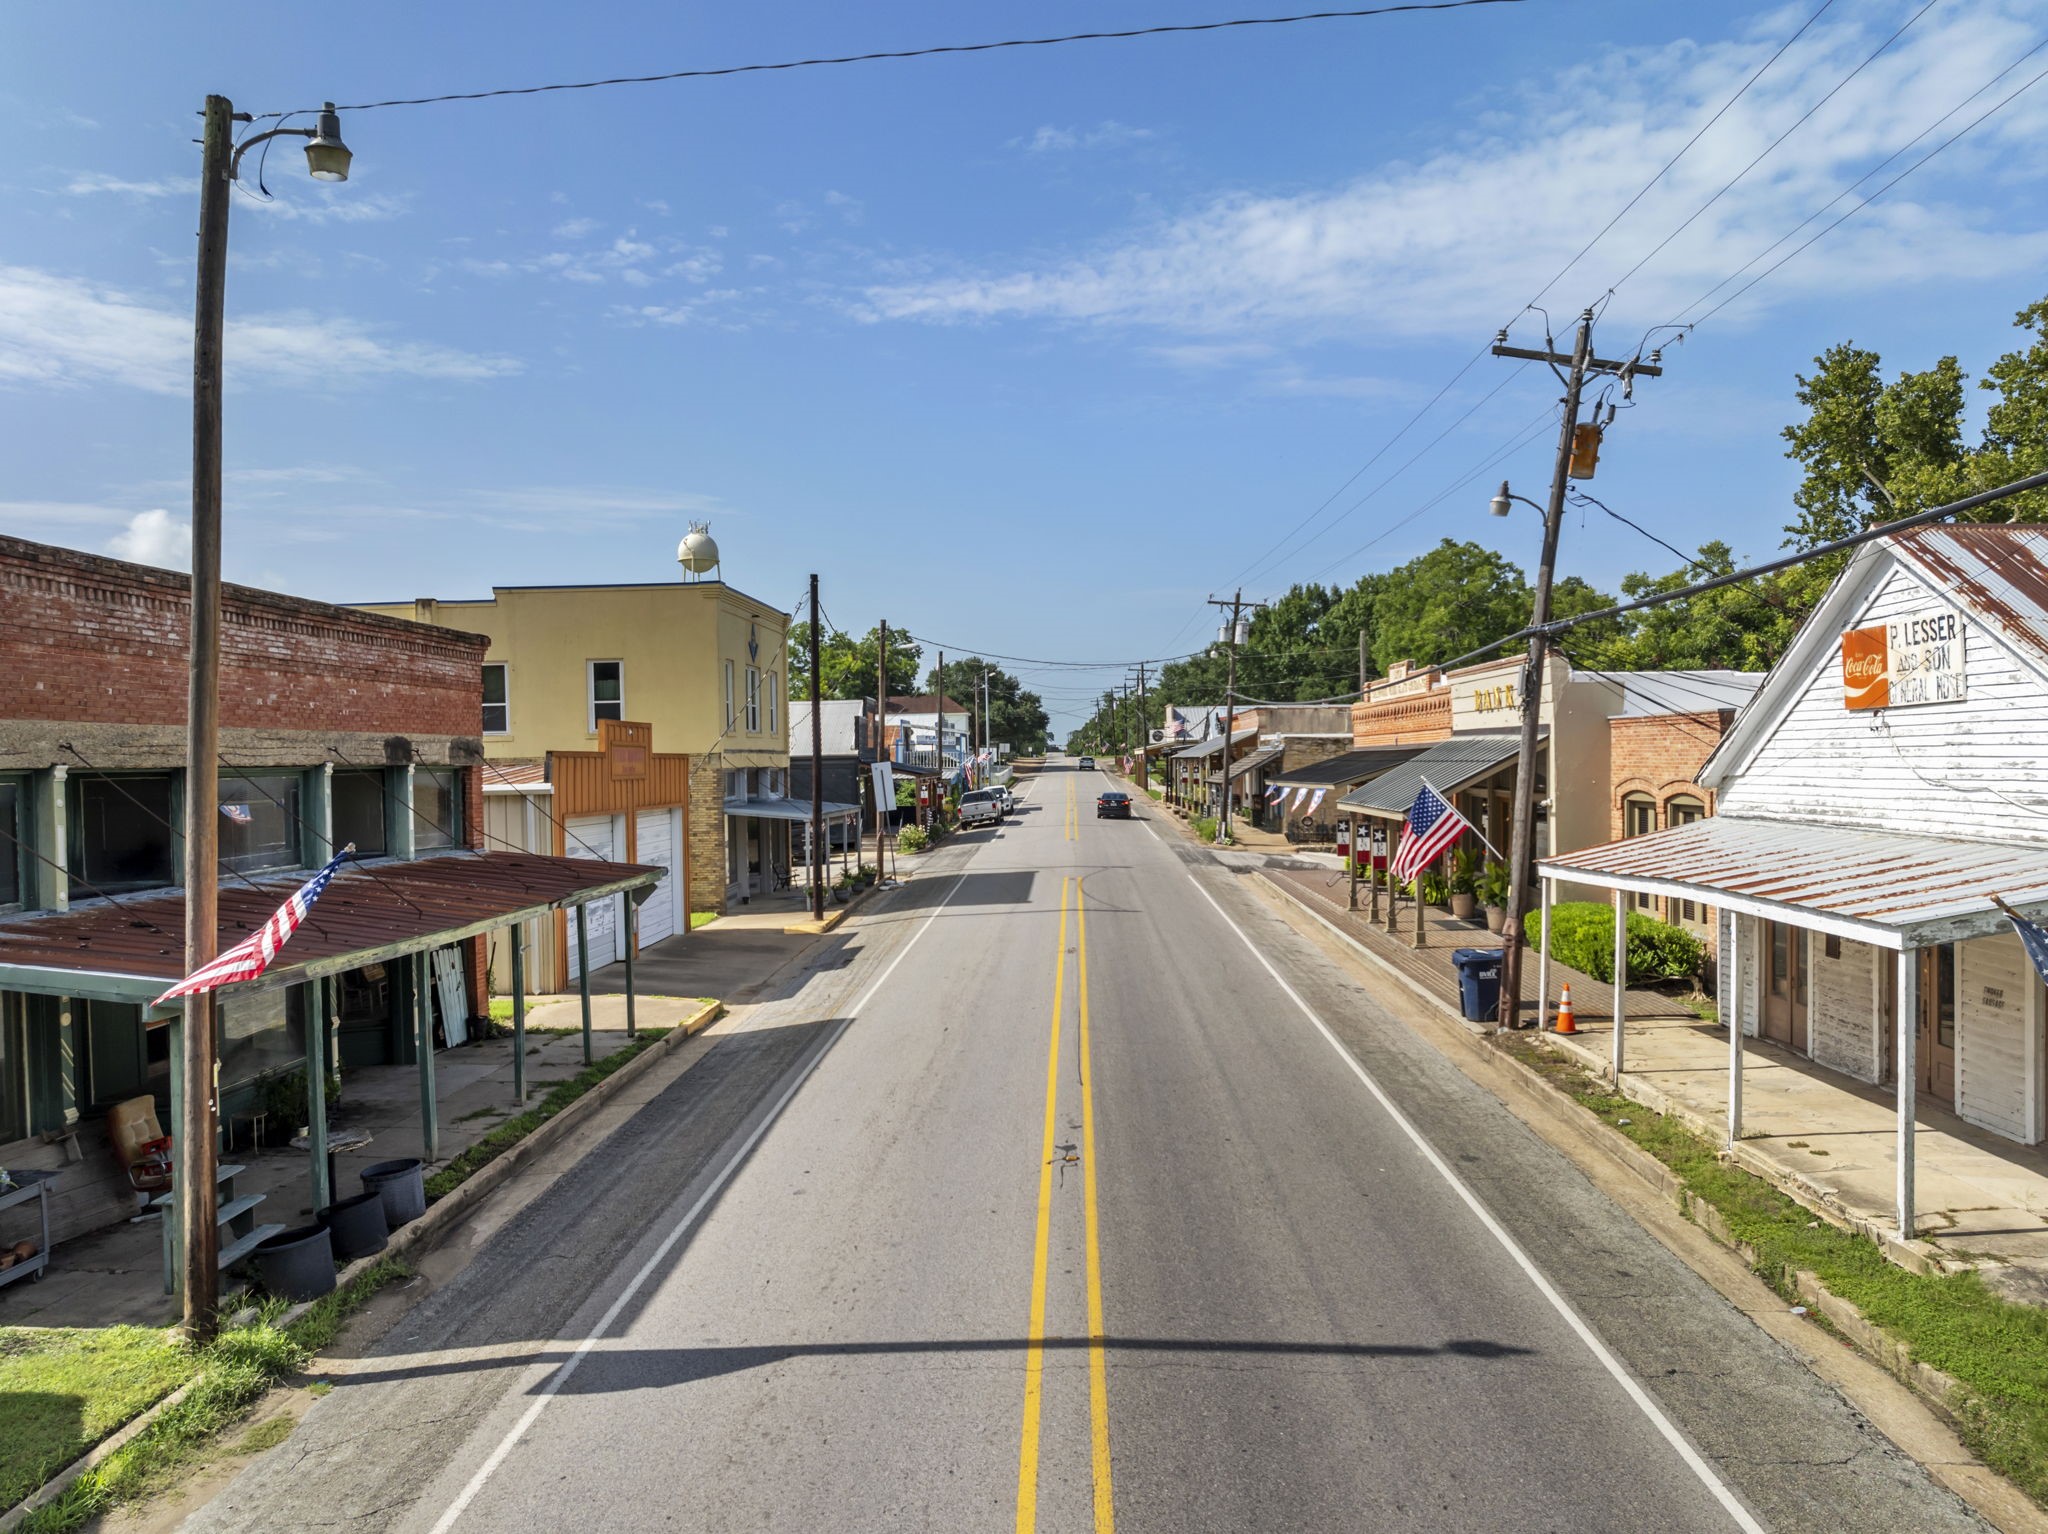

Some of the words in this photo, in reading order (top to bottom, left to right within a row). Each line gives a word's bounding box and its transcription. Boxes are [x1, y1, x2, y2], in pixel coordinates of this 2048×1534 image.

[1890, 625, 1900, 649] P.
[1904, 614, 1956, 646] LESSER
[1845, 654, 1882, 678] Coca-Cola
[1925, 645, 1950, 672] SON
[1474, 684, 1514, 712] BANK
[1889, 678, 1930, 704] GNERAL
